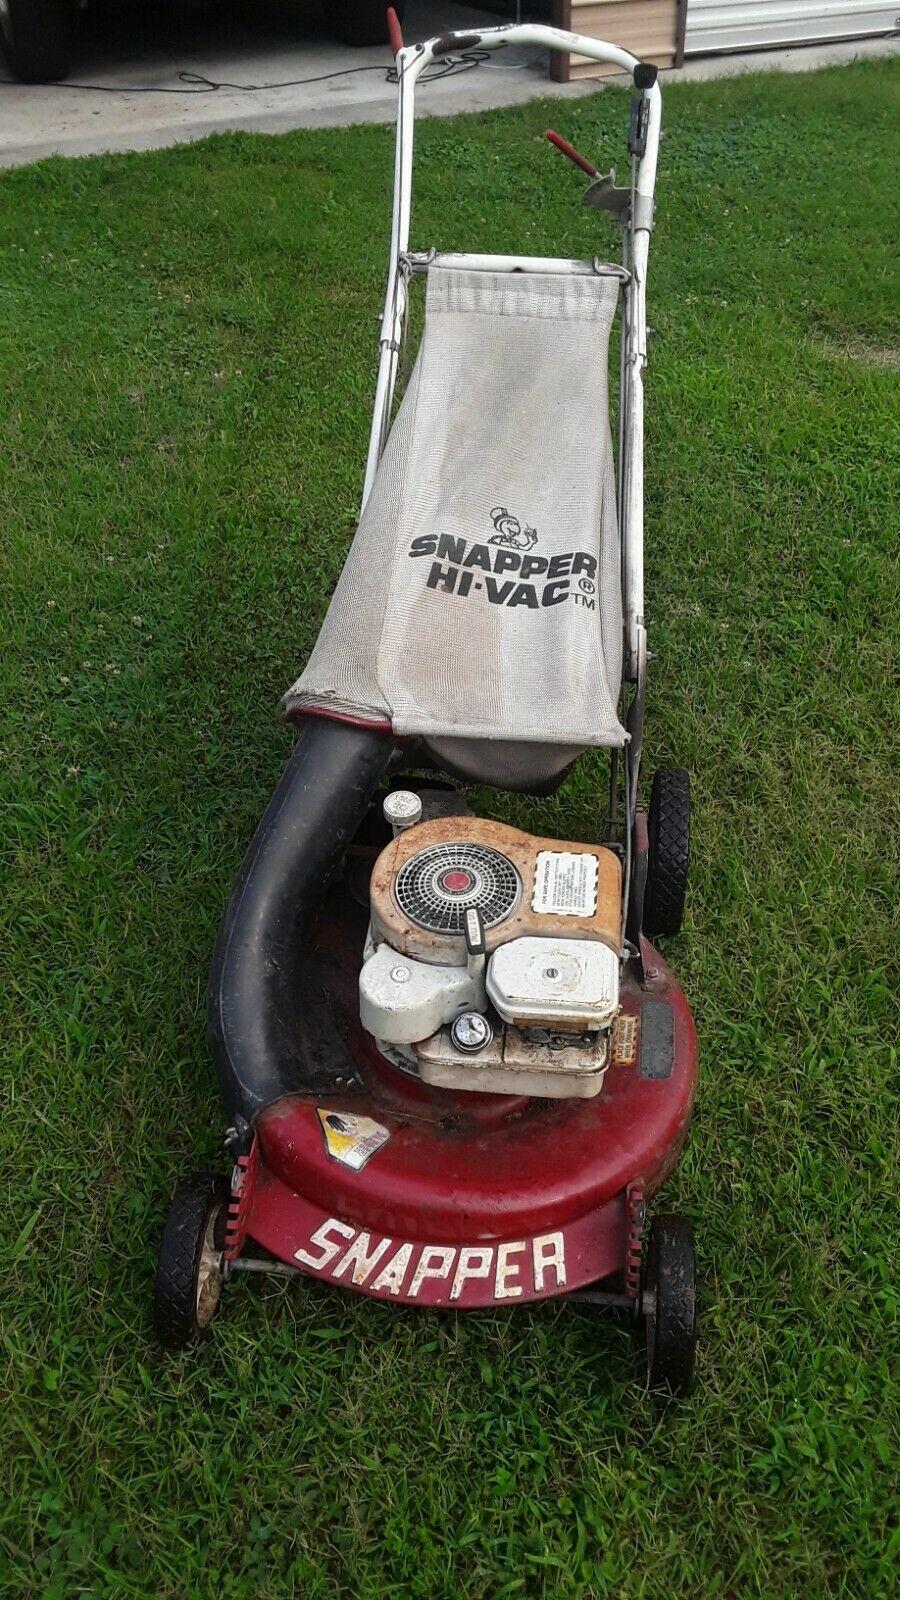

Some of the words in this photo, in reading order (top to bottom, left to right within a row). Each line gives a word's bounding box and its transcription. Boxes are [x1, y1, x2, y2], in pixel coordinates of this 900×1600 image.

[409, 534, 597, 579] SNAPPER
[573, 593, 596, 610] TM
[294, 1218, 566, 1300] SNAPPER
